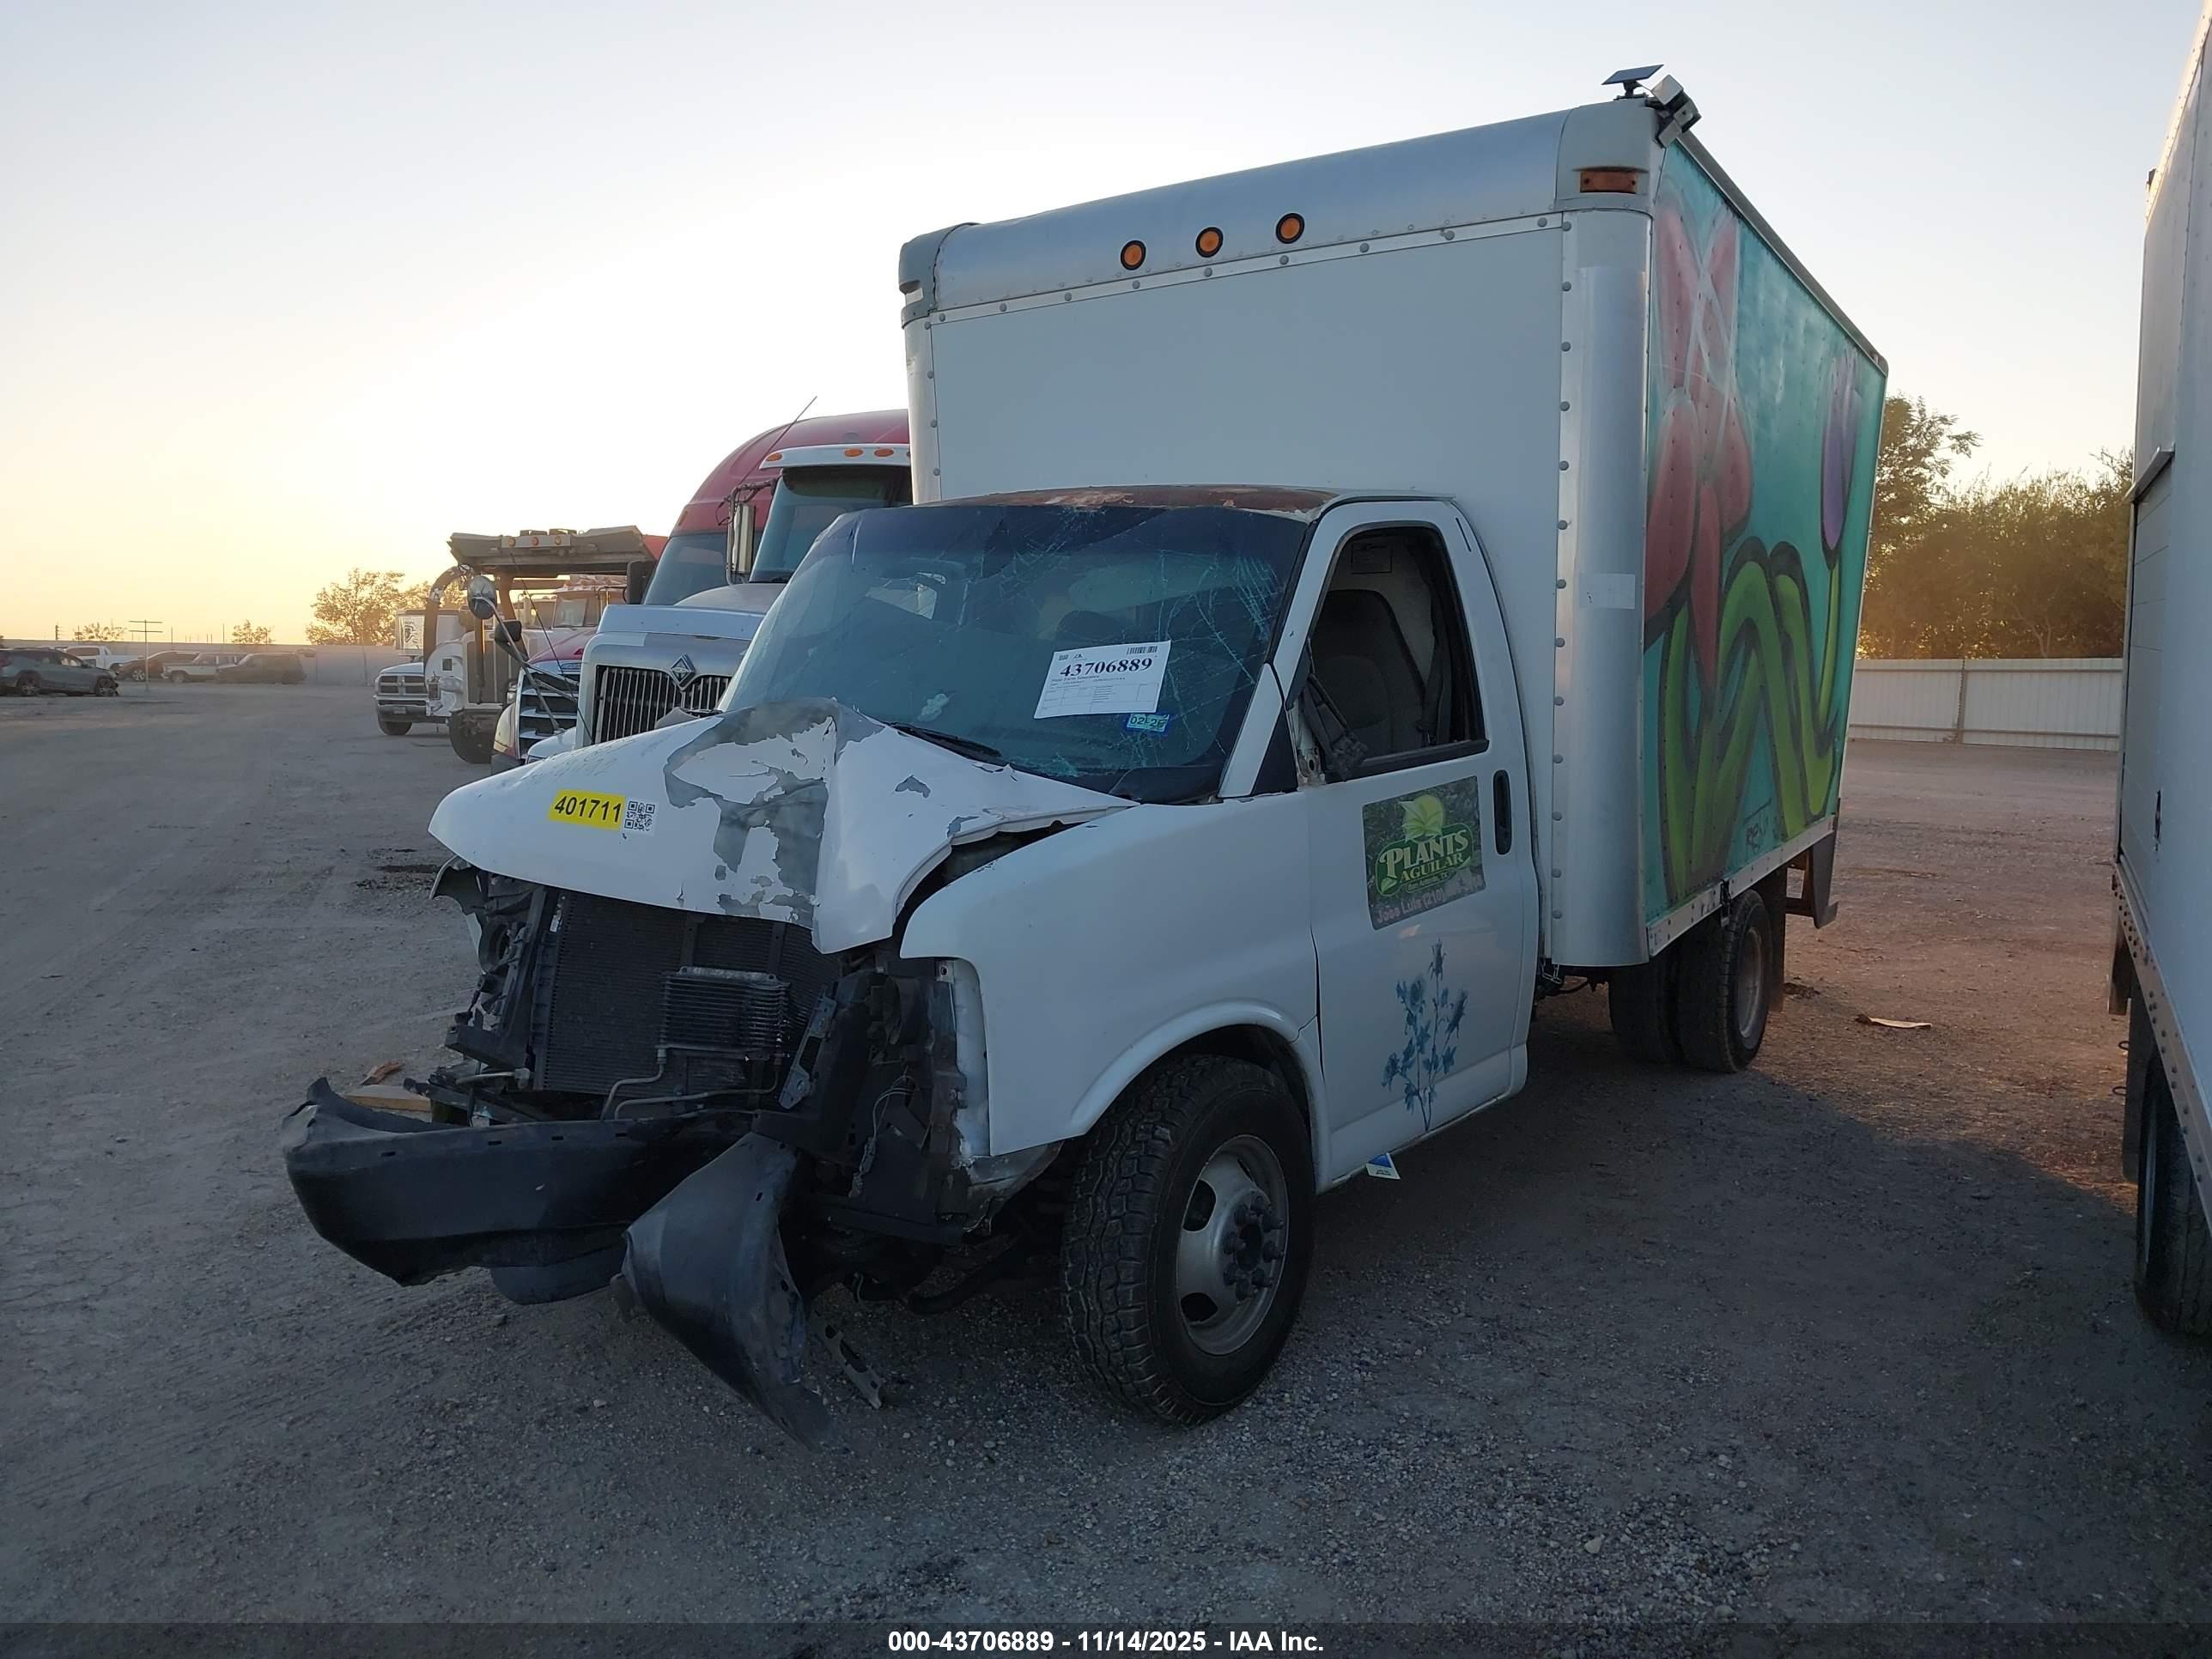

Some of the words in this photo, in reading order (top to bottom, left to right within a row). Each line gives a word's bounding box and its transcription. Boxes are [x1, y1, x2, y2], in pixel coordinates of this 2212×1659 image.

[1060, 658, 1153, 677] 43706889
[554, 795, 622, 823] 401711
[1380, 830, 1468, 878] PLANTS
[1401, 853, 1464, 880] AGUILAR
